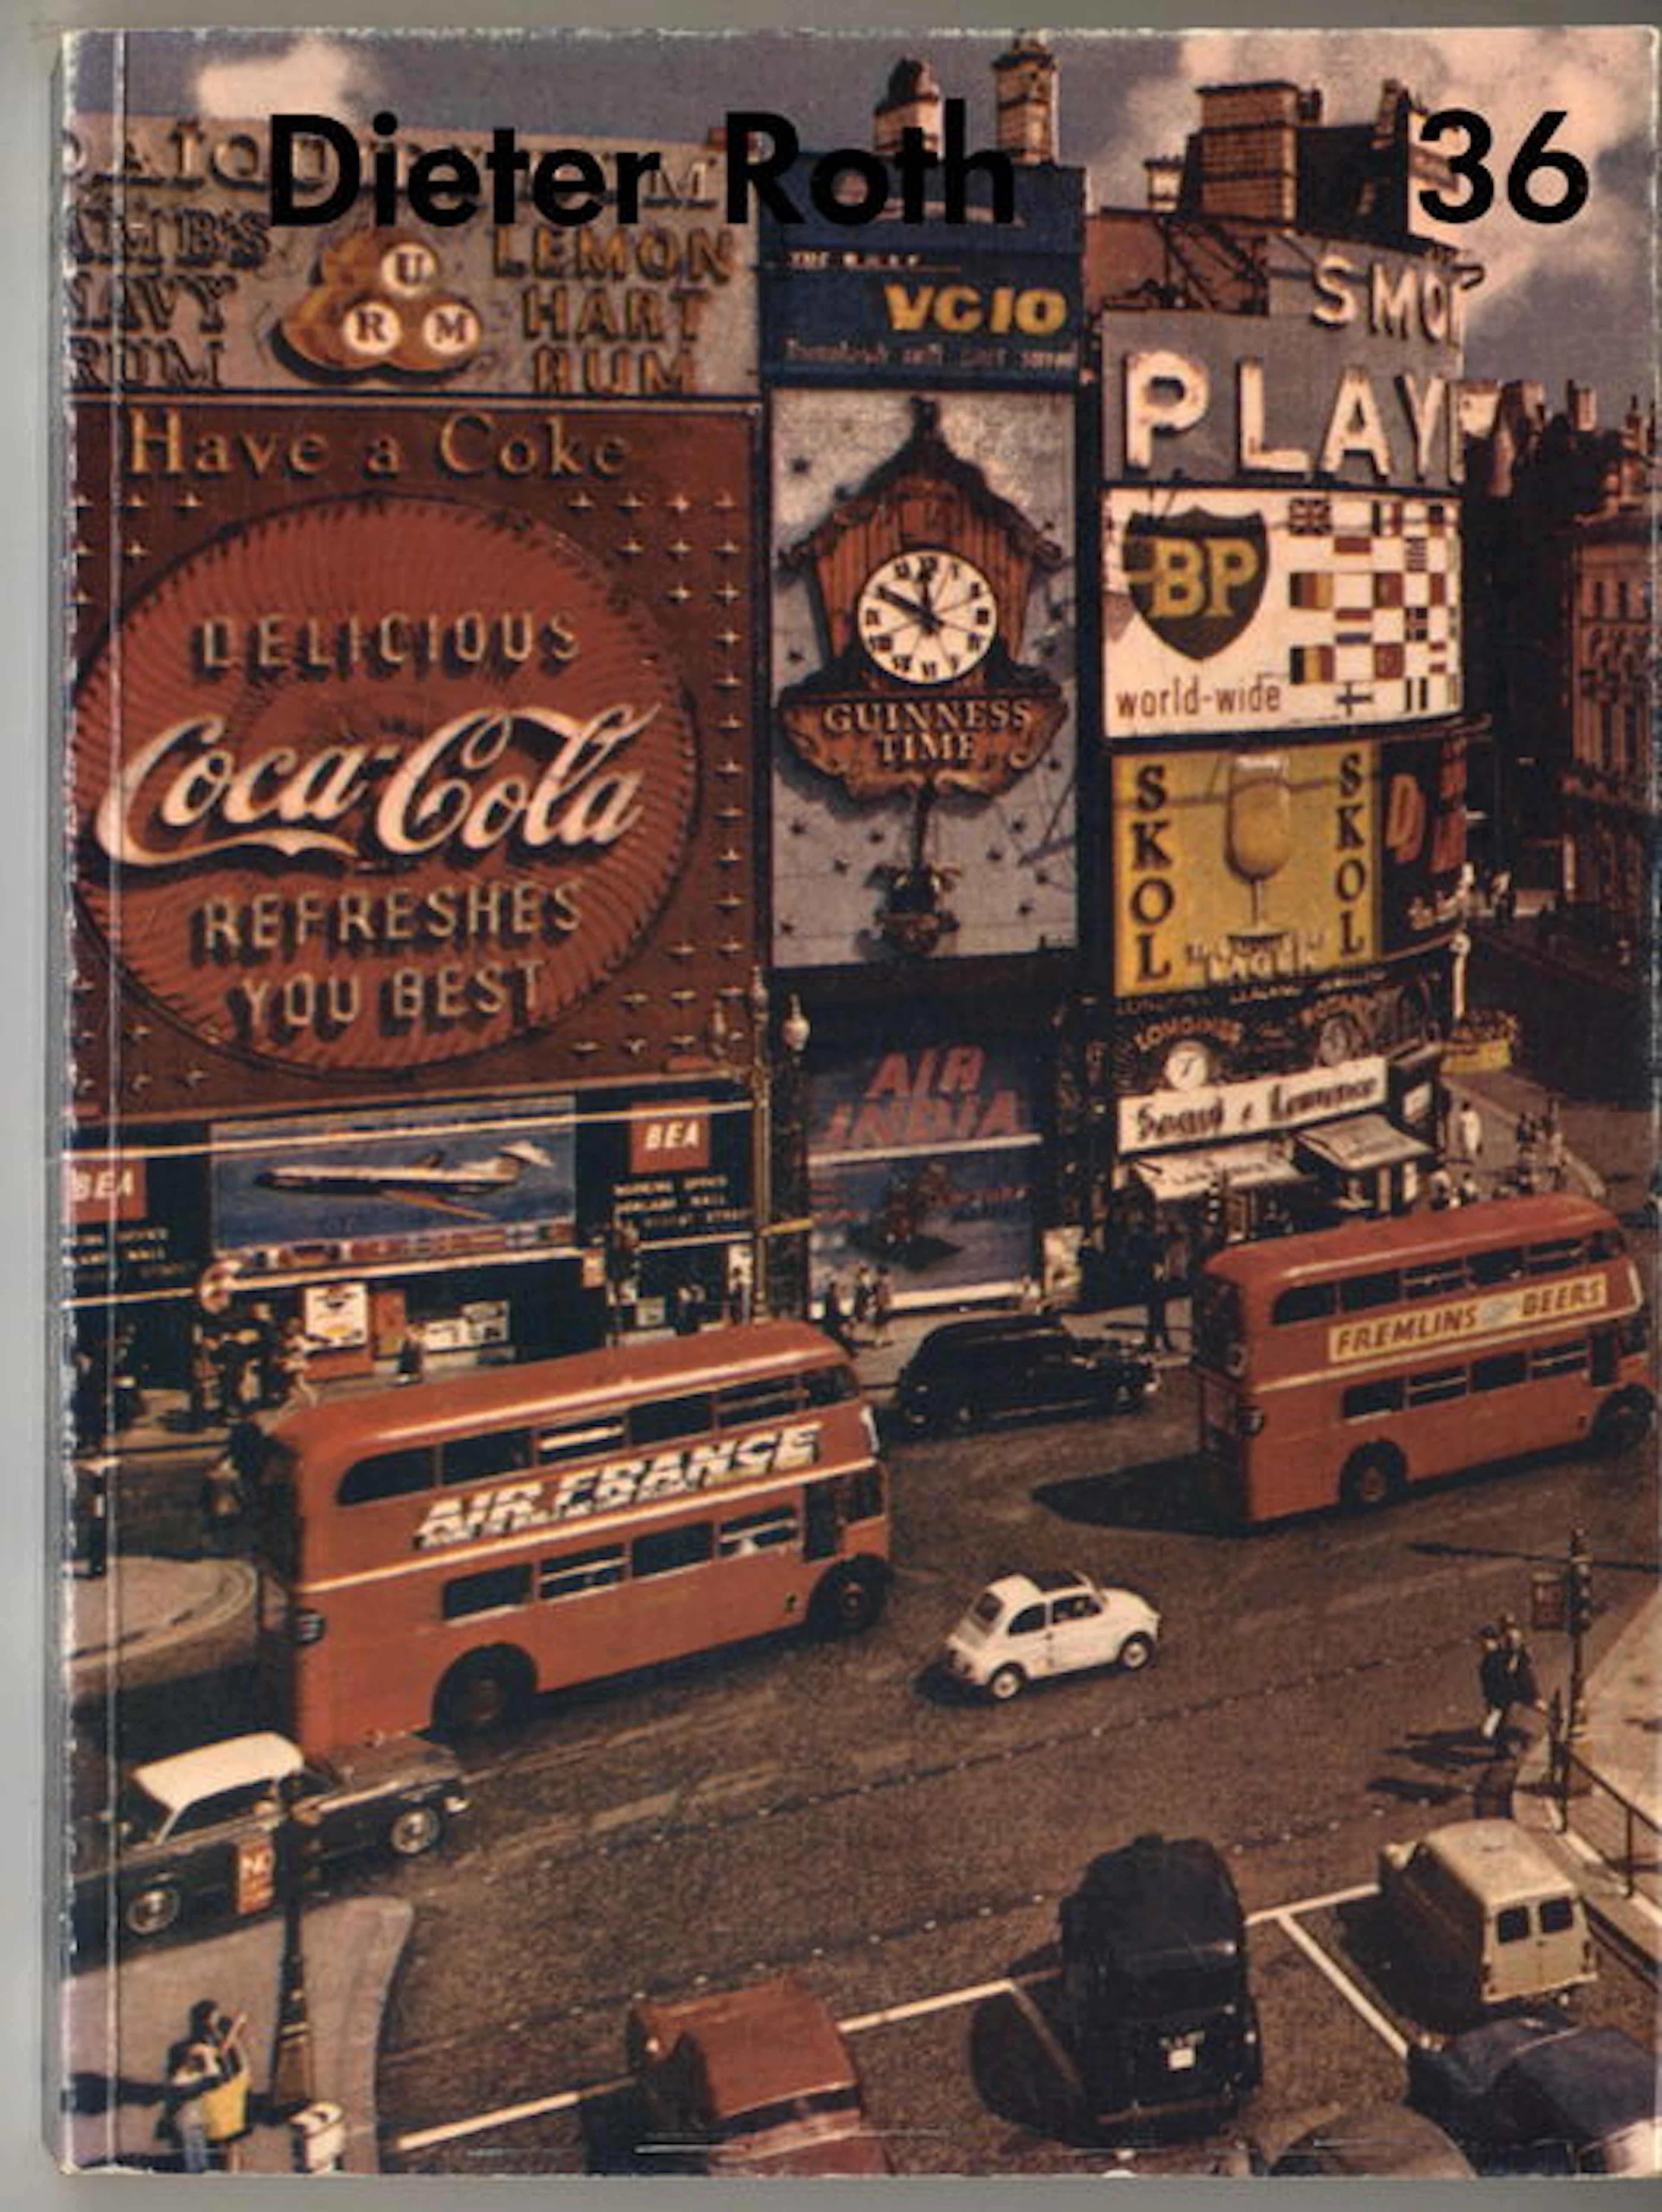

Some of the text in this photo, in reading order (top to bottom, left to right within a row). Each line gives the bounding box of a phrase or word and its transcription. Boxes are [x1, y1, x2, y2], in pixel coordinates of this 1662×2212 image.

[493, 226, 734, 285] LEMON
[523, 285, 710, 342] HART
[1313, 255, 1465, 346] SMO
[129, 407, 631, 480] Have a Coke
[1126, 350, 1465, 484] PLAY
[1146, 538, 1259, 618] BP
[197, 610, 581, 669] DELICIOUS
[825, 699, 1032, 733] GUINNESS
[1117, 678, 1282, 717] world-wide
[879, 733, 977, 761] TIME
[96, 703, 661, 865] Coca-Cola
[1131, 764, 1174, 983] SKOL
[1336, 753, 1366, 957] SKOL
[200, 877, 585, 952] REFRESHES
[239, 960, 544, 1026] YOU BEST
[864, 1045, 985, 1099] AIR
[644, 1122, 699, 1151] BEA
[1335, 1280, 1604, 1354] FREMLINS BEERS
[414, 1422, 823, 1548] AIR FRANCE
